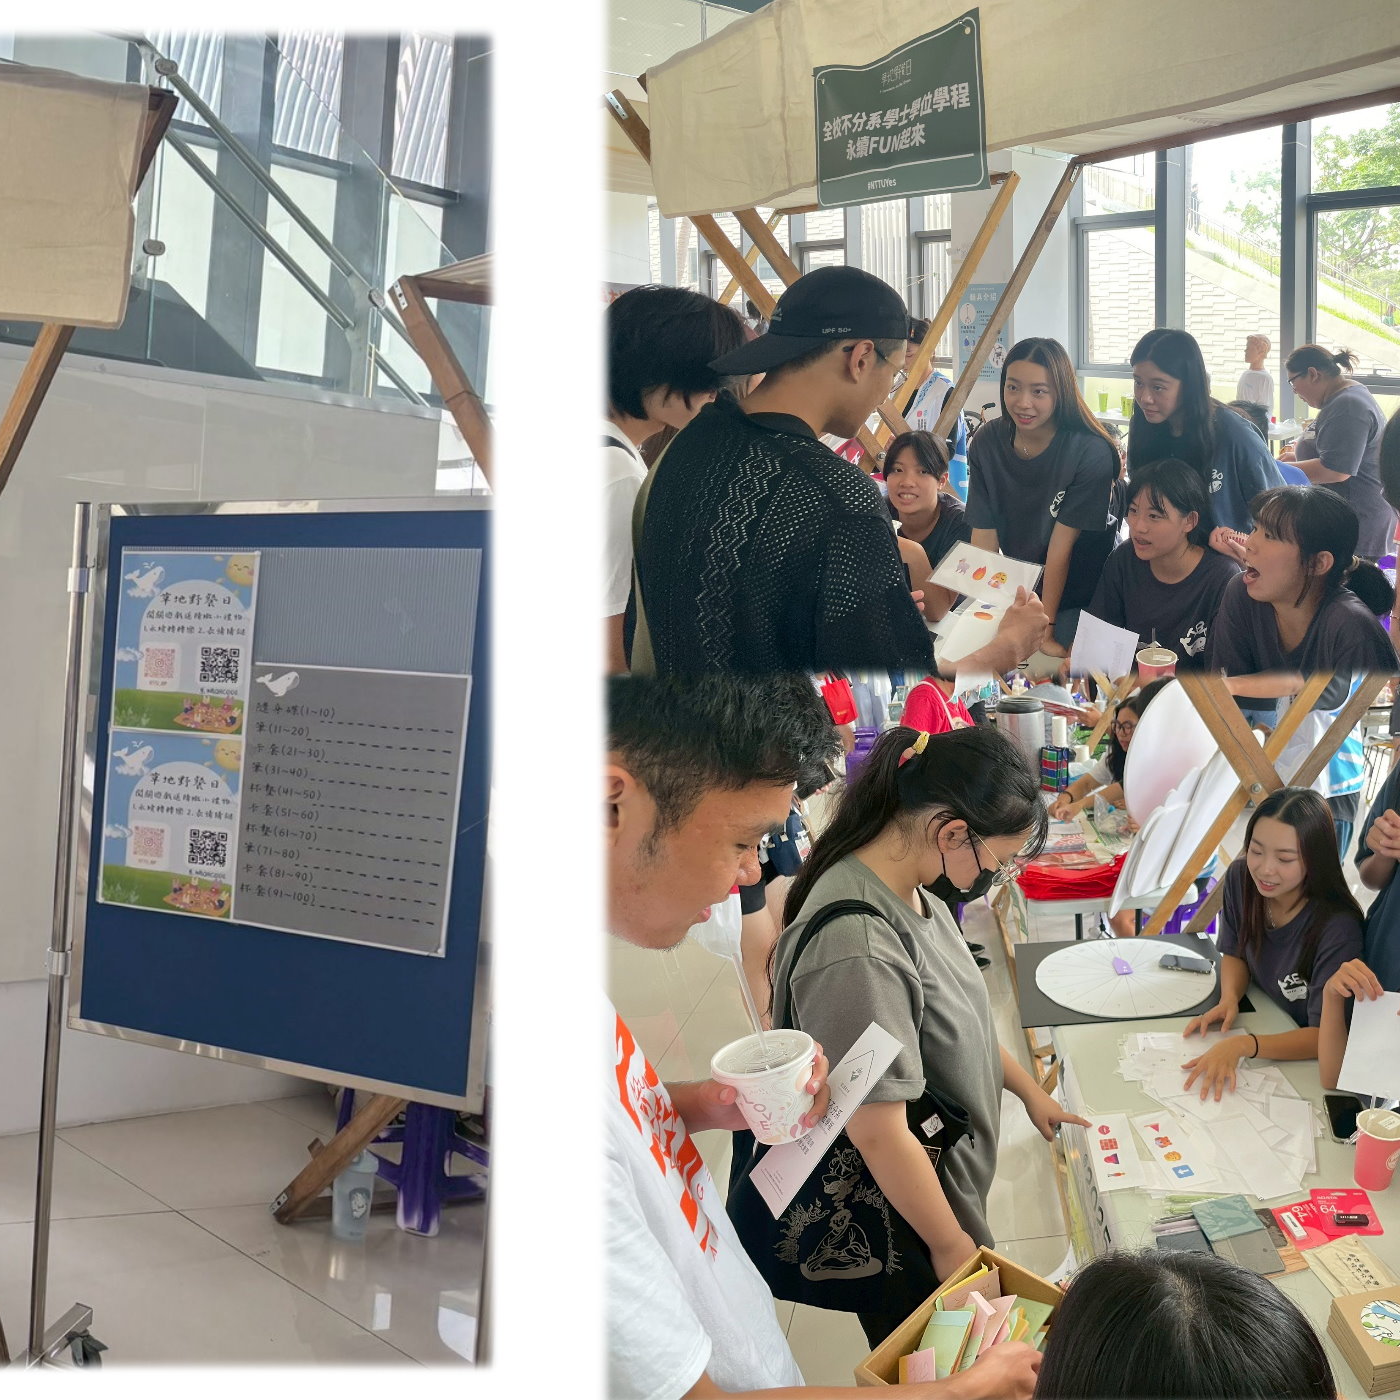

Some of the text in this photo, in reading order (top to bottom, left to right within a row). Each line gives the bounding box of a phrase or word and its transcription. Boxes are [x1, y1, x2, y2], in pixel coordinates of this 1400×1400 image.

[822, 82, 971, 142] 全校不分系學士學位學程
[846, 123, 926, 161] 永續FUN起來
[867, 178, 897, 191] #NTTUYes
[1320, 1205, 1337, 1214] 64
